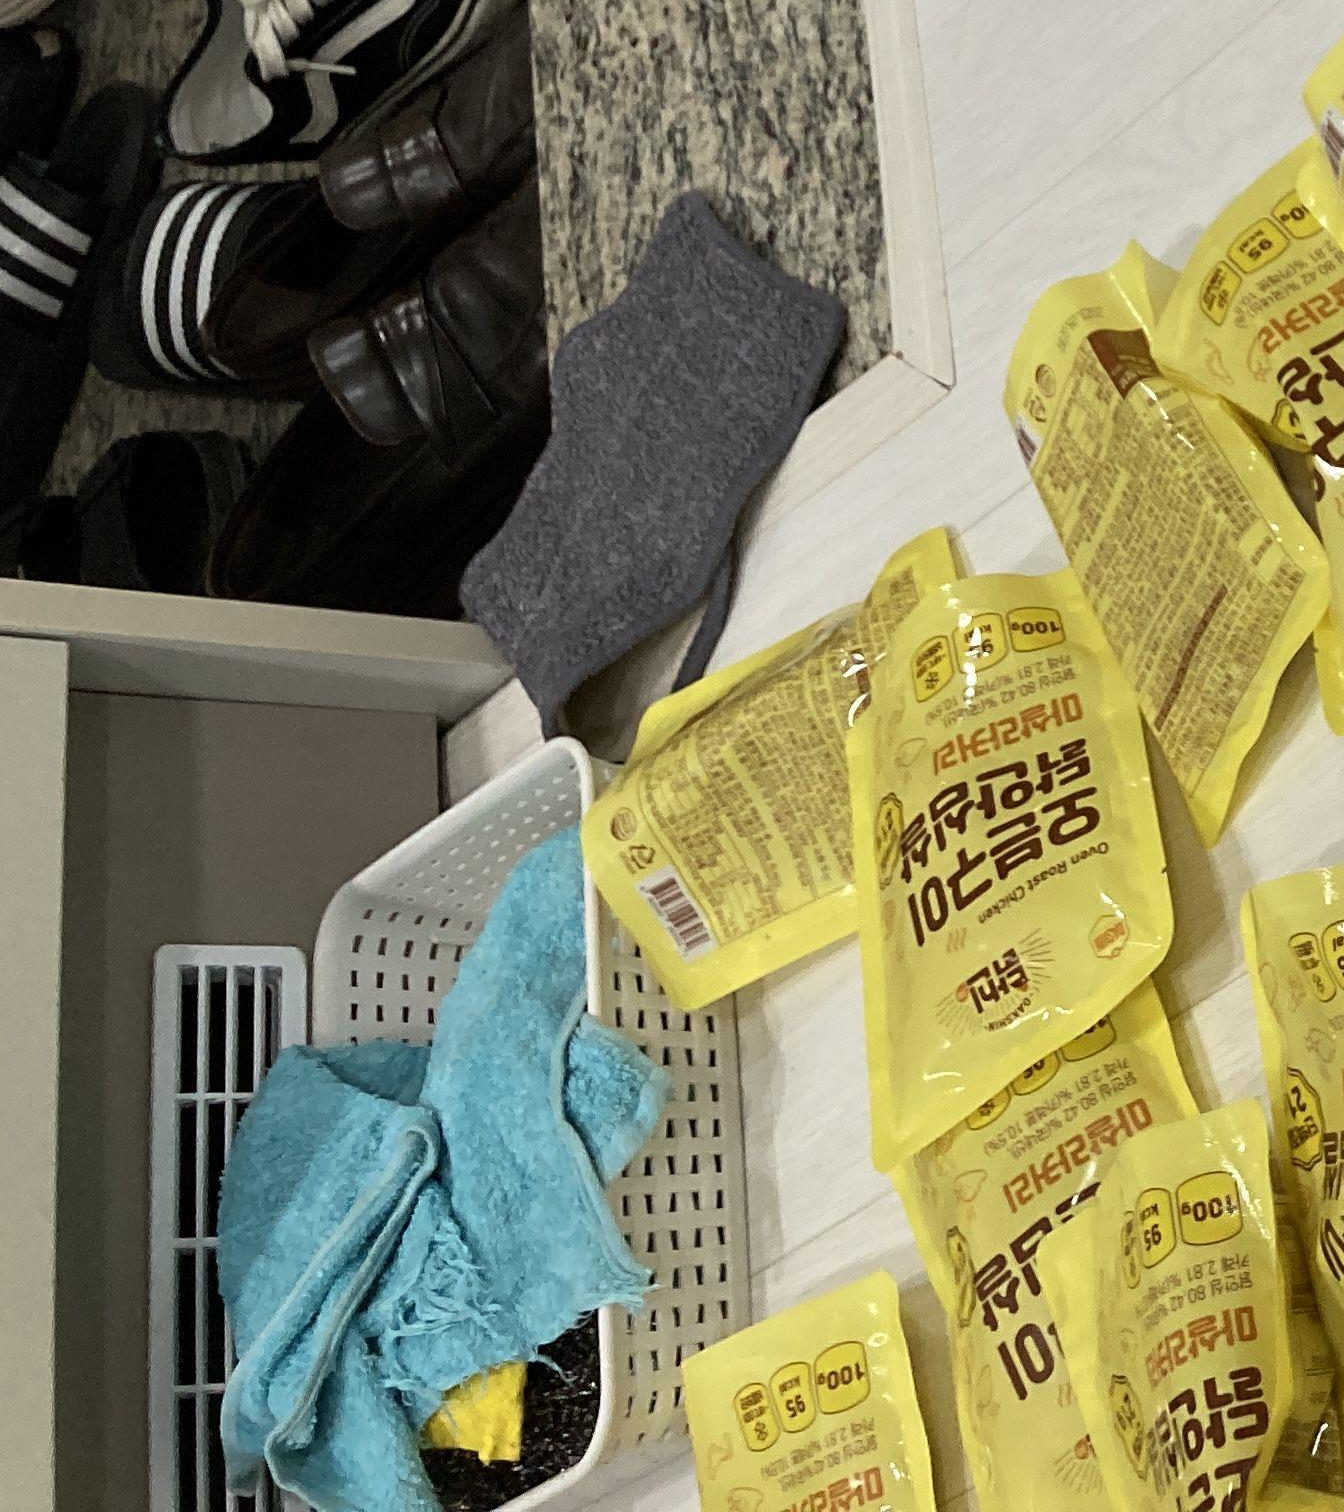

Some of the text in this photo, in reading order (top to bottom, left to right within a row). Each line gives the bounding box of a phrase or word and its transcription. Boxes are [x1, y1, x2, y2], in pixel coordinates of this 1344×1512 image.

[1243, 234, 1274, 262] 95
[1009, 616, 1060, 638] 100g
[927, 689, 1084, 775] 마살라커리
[897, 736, 1093, 883] 닭안심살
[906, 783, 1103, 946] 오븐구이
[976, 840, 1110, 924] Oven Roast Chicken
[963, 947, 1030, 1013] 닭신
[1000, 1096, 1155, 1214] 마살라커리
[1180, 1193, 1238, 1223] 100g
[784, 1393, 806, 1417] 95
[815, 1361, 865, 1392] 100g
